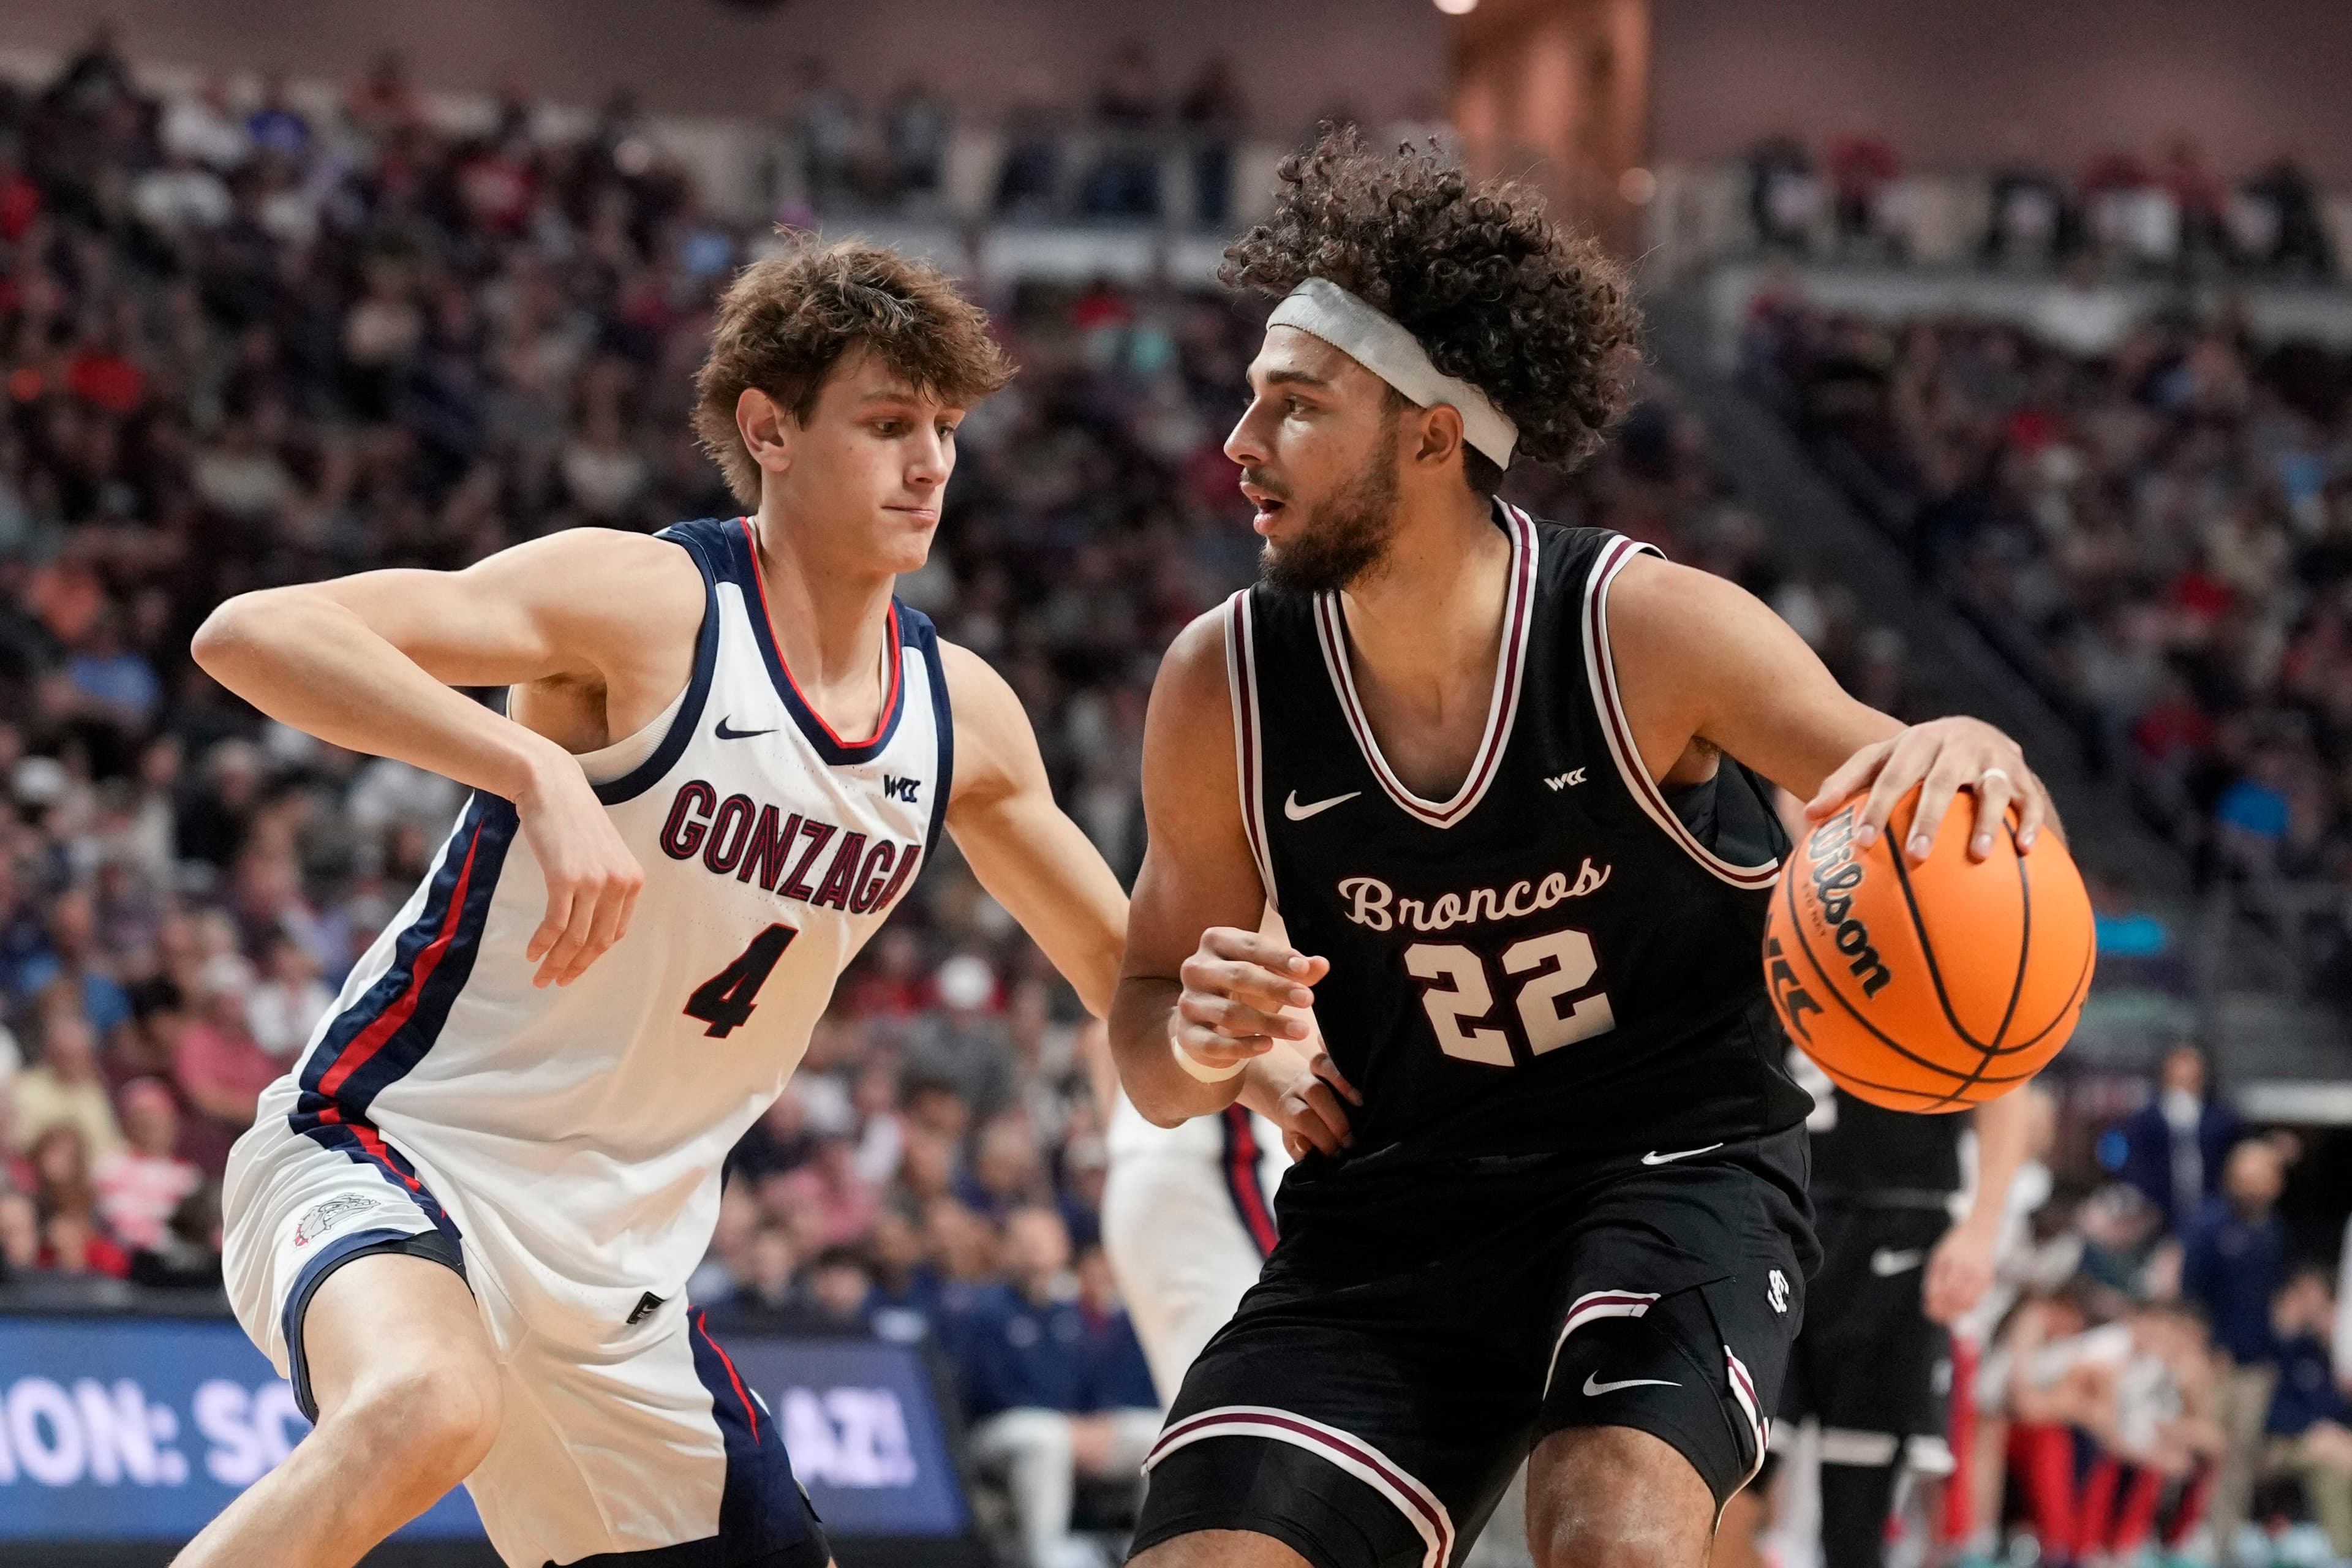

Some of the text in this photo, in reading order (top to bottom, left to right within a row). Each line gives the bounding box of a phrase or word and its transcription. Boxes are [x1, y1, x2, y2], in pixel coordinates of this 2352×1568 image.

[1544, 766, 1588, 792] WCC
[660, 779, 922, 915] GONZAGA
[1338, 858, 1612, 932] Broncos
[1809, 804, 1892, 1000] Wilson
[682, 922, 799, 1039] 4
[1403, 929, 1617, 1067] 22
